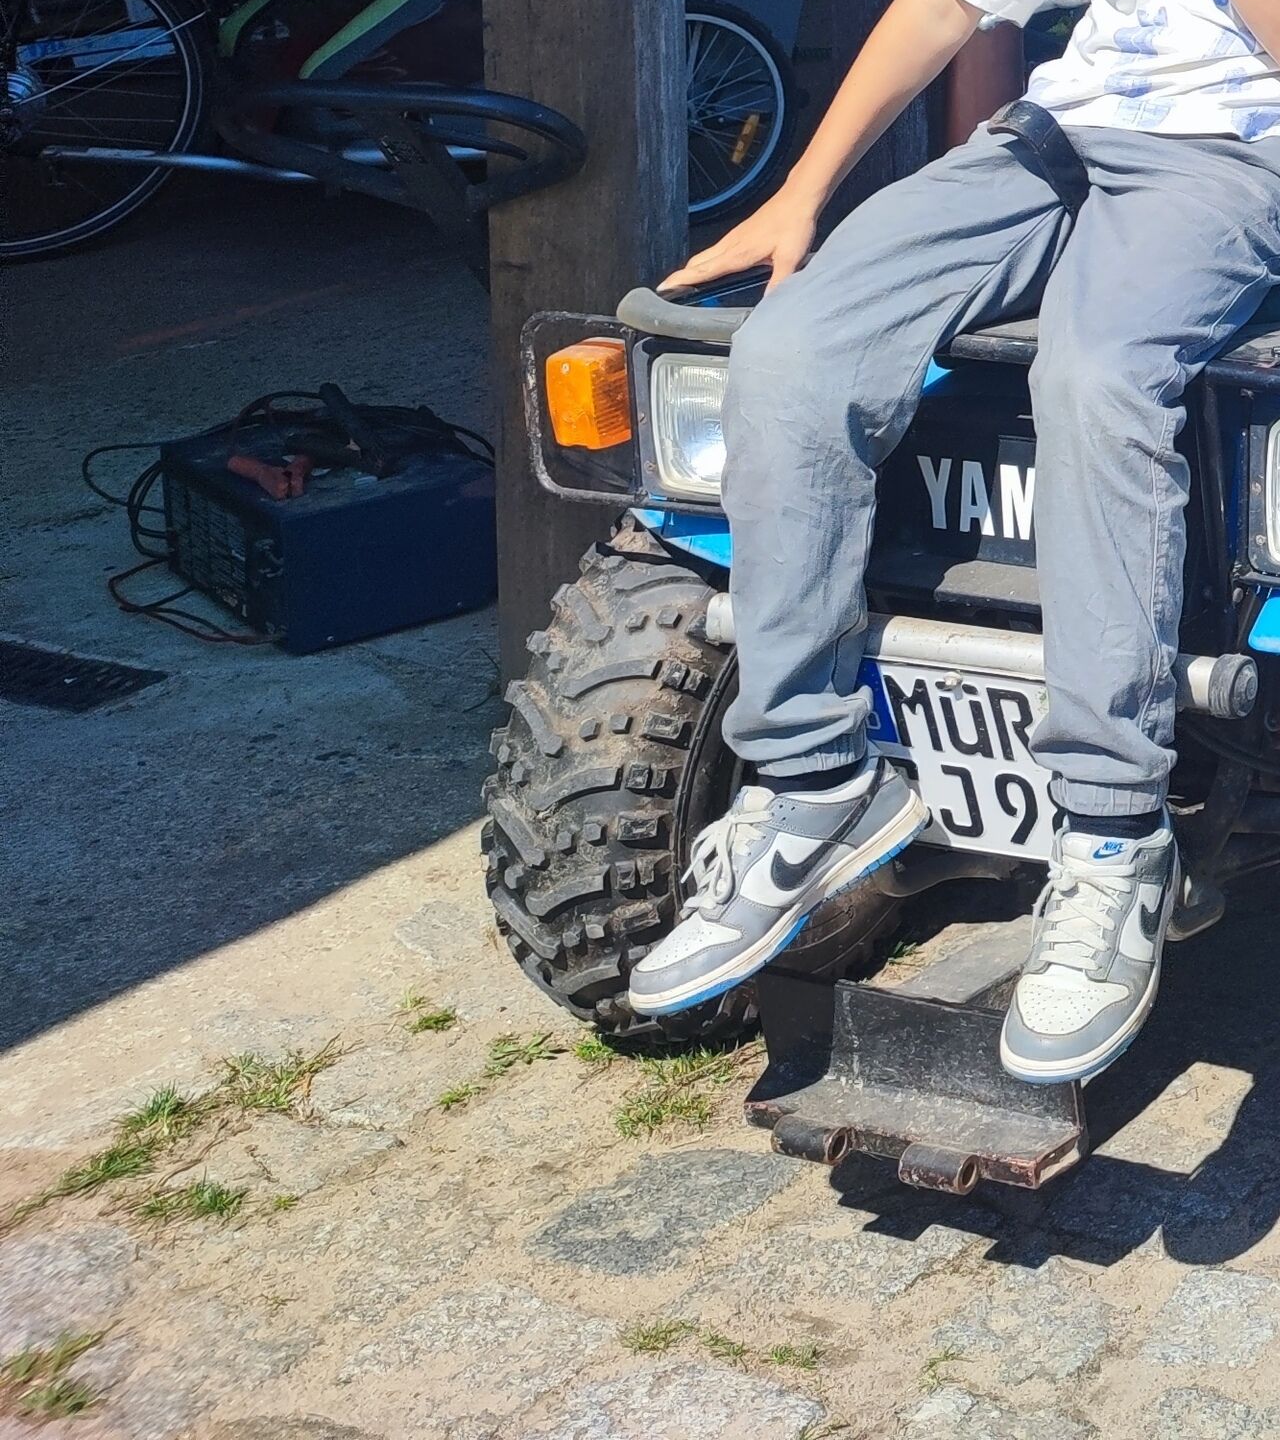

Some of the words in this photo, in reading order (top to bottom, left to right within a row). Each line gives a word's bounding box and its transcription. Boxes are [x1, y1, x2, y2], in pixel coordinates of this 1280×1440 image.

[916, 455, 1036, 541] YAM
[883, 674, 1037, 762] MÜR
[1102, 841, 1125, 852] NIKE
